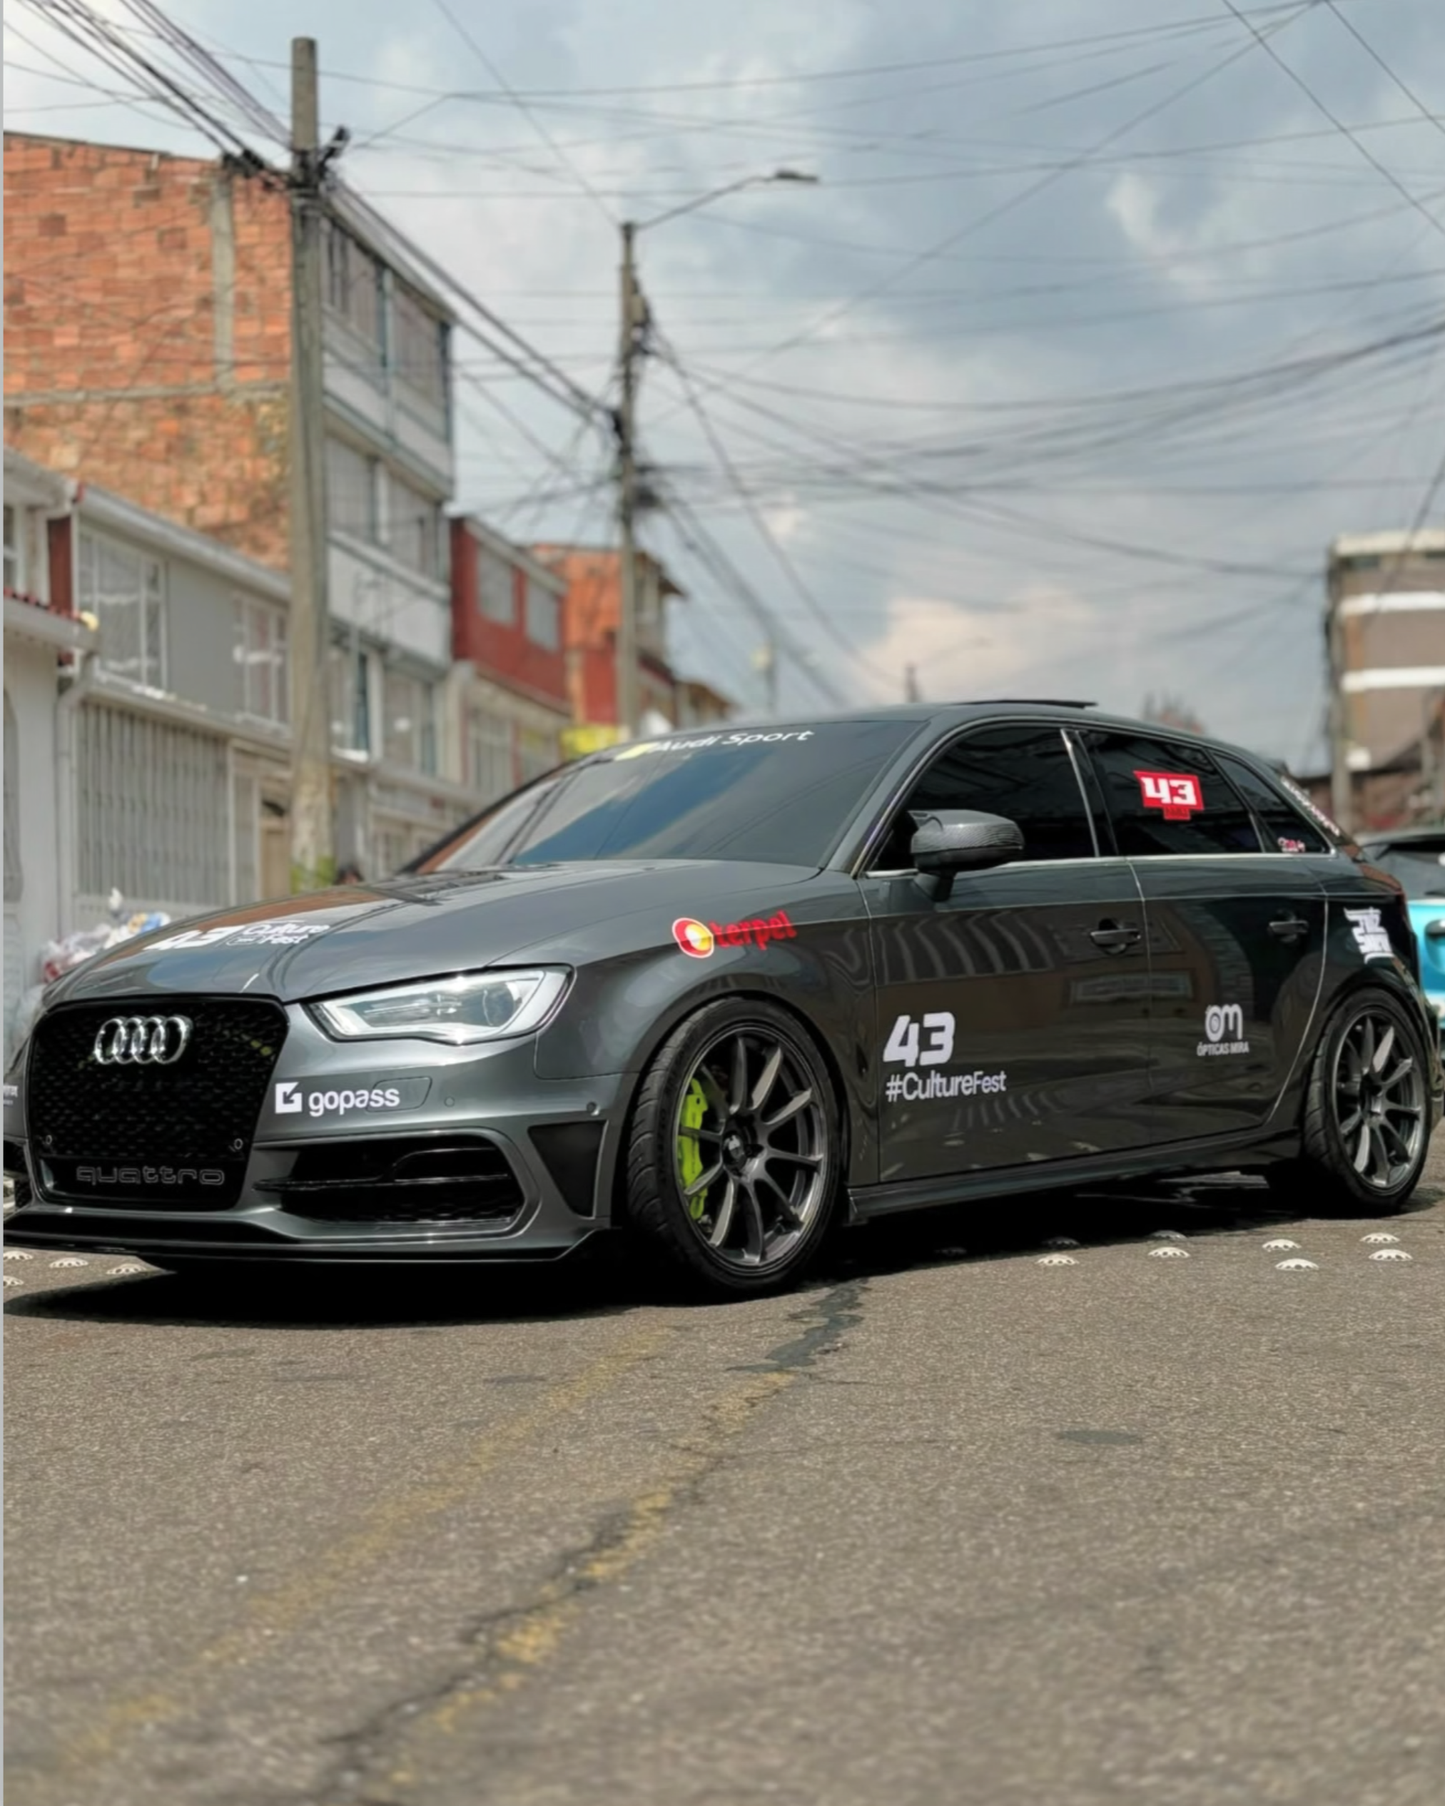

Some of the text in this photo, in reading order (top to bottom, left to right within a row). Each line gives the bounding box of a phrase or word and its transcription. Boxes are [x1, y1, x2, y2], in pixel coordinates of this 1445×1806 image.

[652, 730, 815, 753] Audi Sport
[1140, 776, 1198, 806] 43
[143, 925, 245, 951] 43
[242, 923, 331, 936] Culture
[258, 933, 311, 945] Fest
[709, 909, 798, 950] terpel
[883, 1012, 955, 1067] 43
[886, 1070, 1008, 1103] #CultureFest
[309, 1086, 400, 1117] gopass
[75, 1165, 226, 1187] quattro
